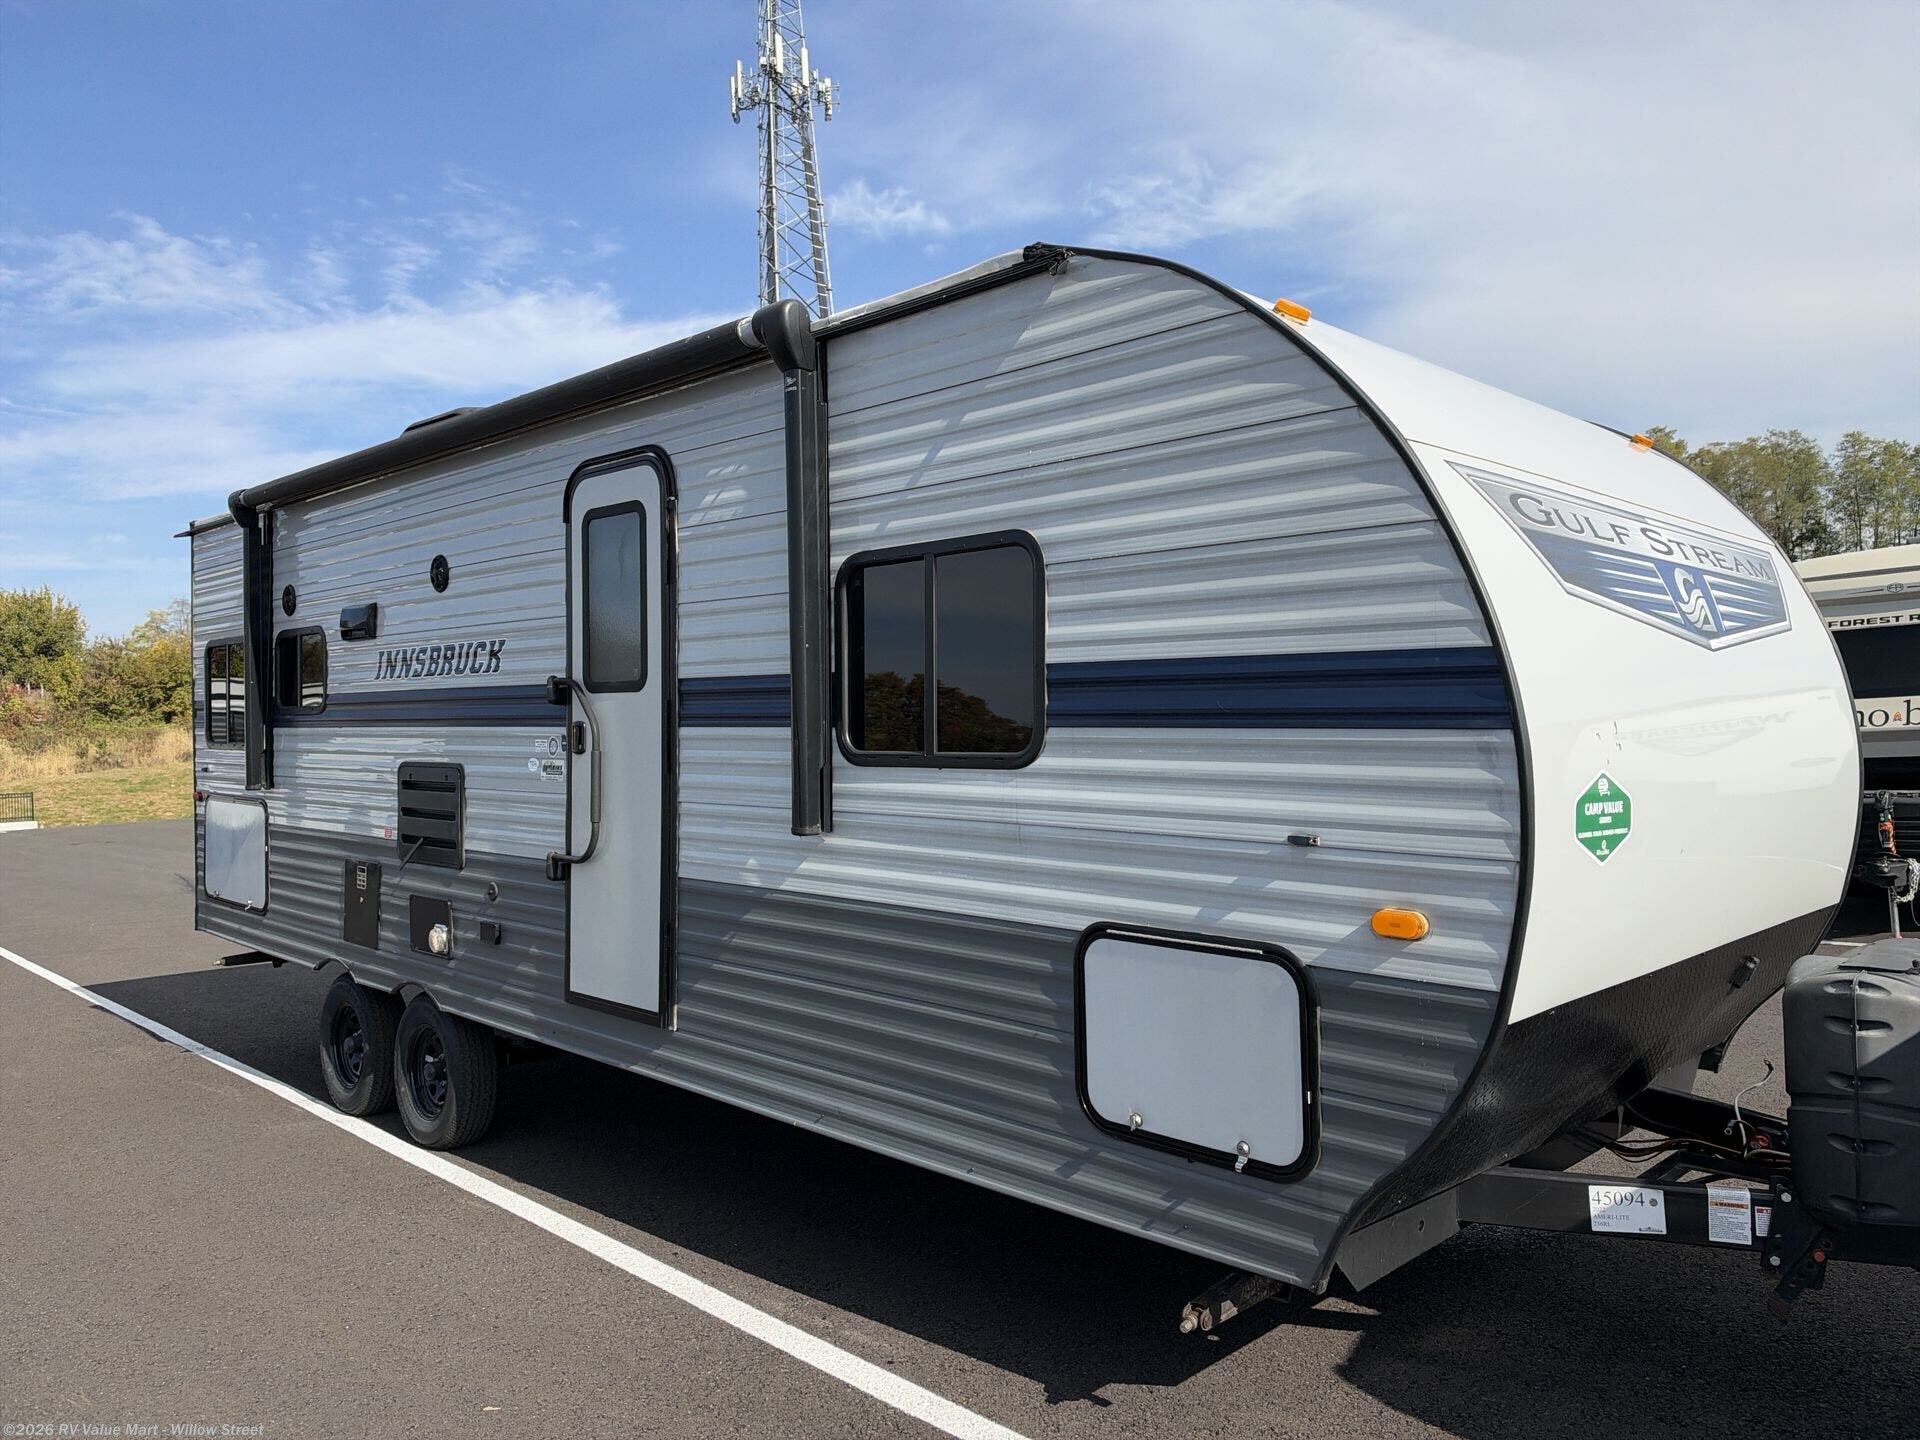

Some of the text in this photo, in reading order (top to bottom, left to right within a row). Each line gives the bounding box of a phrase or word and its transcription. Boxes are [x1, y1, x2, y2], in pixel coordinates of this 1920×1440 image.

[1509, 493, 1773, 582] GULF STREAM
[1828, 615, 1904, 629] FOREST
[373, 638, 507, 681] INNSBRUCK
[1585, 801, 1623, 815] CAMP VALUE
[1591, 1190, 1646, 1207] 45094
[1593, 1213, 1630, 1221] AMERI-LITE
